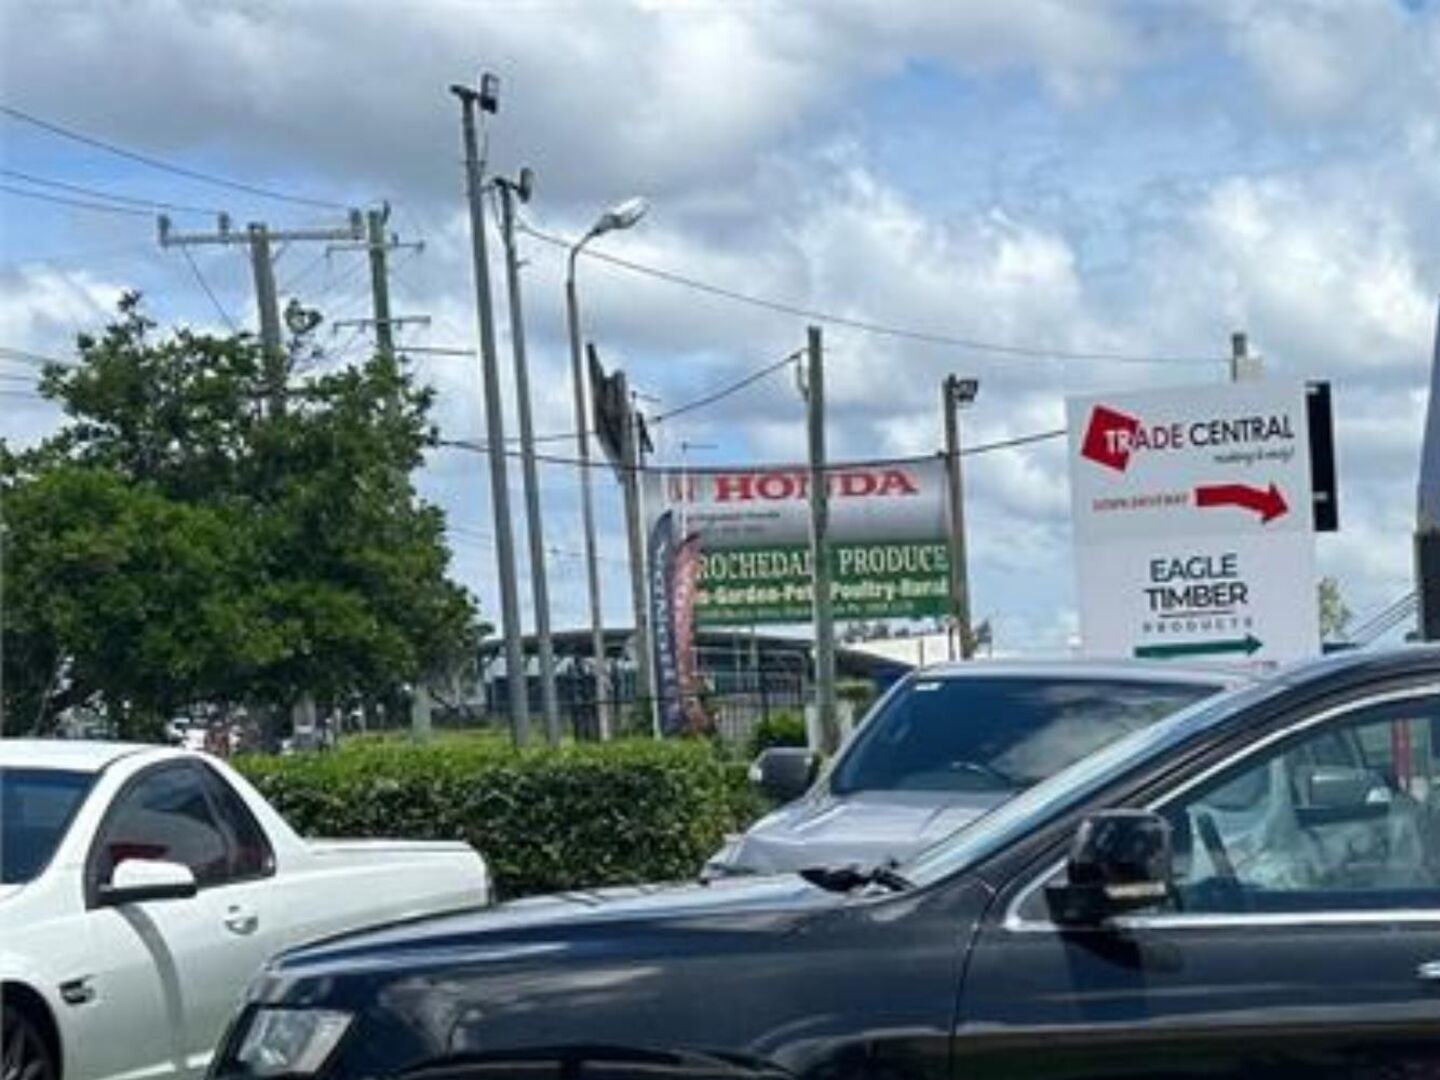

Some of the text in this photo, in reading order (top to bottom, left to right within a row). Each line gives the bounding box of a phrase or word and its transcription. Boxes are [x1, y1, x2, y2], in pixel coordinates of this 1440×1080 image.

[1103, 414, 1295, 454] TRADE CENTRAL
[839, 543, 951, 576] PRODUCE
[1149, 552, 1238, 583] EAGLE
[1143, 581, 1249, 612] TIMBER
[1142, 616, 1254, 633] PRODUCTS
